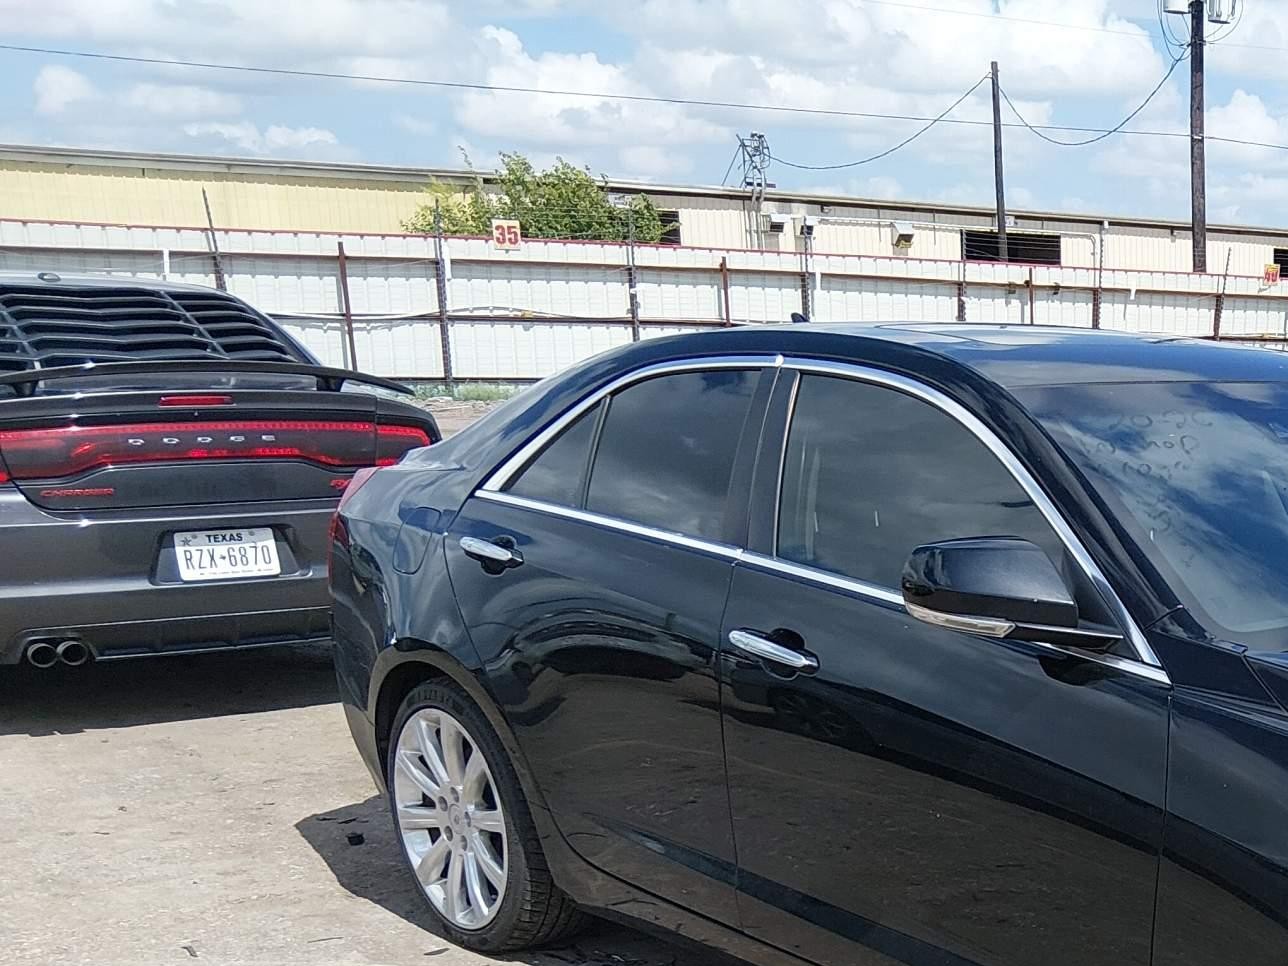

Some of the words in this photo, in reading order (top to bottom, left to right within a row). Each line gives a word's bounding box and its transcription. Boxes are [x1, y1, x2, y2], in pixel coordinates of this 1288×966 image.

[495, 225, 519, 245] 35
[127, 434, 276, 446] DODGE
[205, 532, 243, 544] TEXAS
